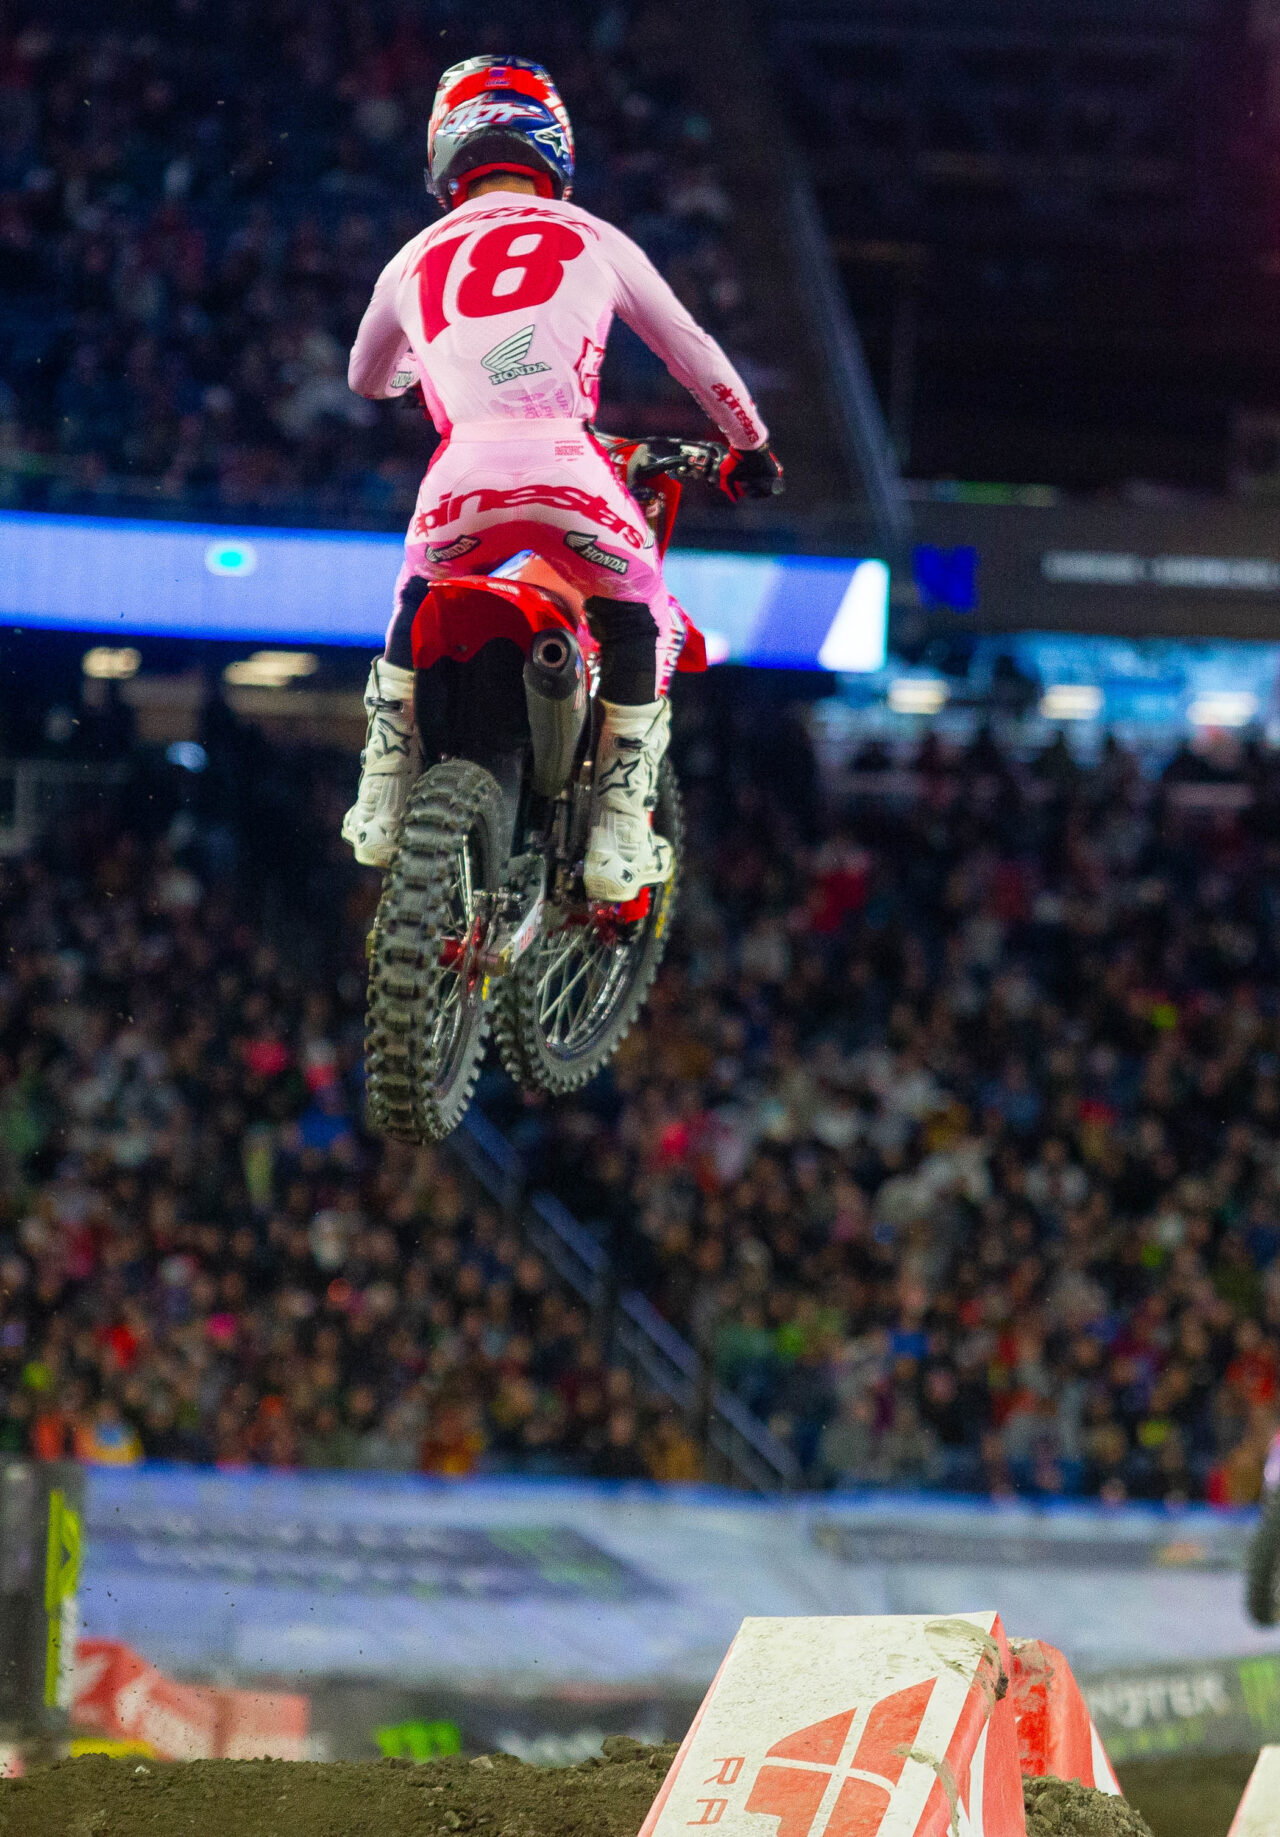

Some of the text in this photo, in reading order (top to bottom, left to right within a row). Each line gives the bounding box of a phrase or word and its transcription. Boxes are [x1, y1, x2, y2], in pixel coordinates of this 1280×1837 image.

[410, 220, 585, 344] 18
[489, 361, 552, 385] HONDA
[584, 544, 628, 573] HONDA
